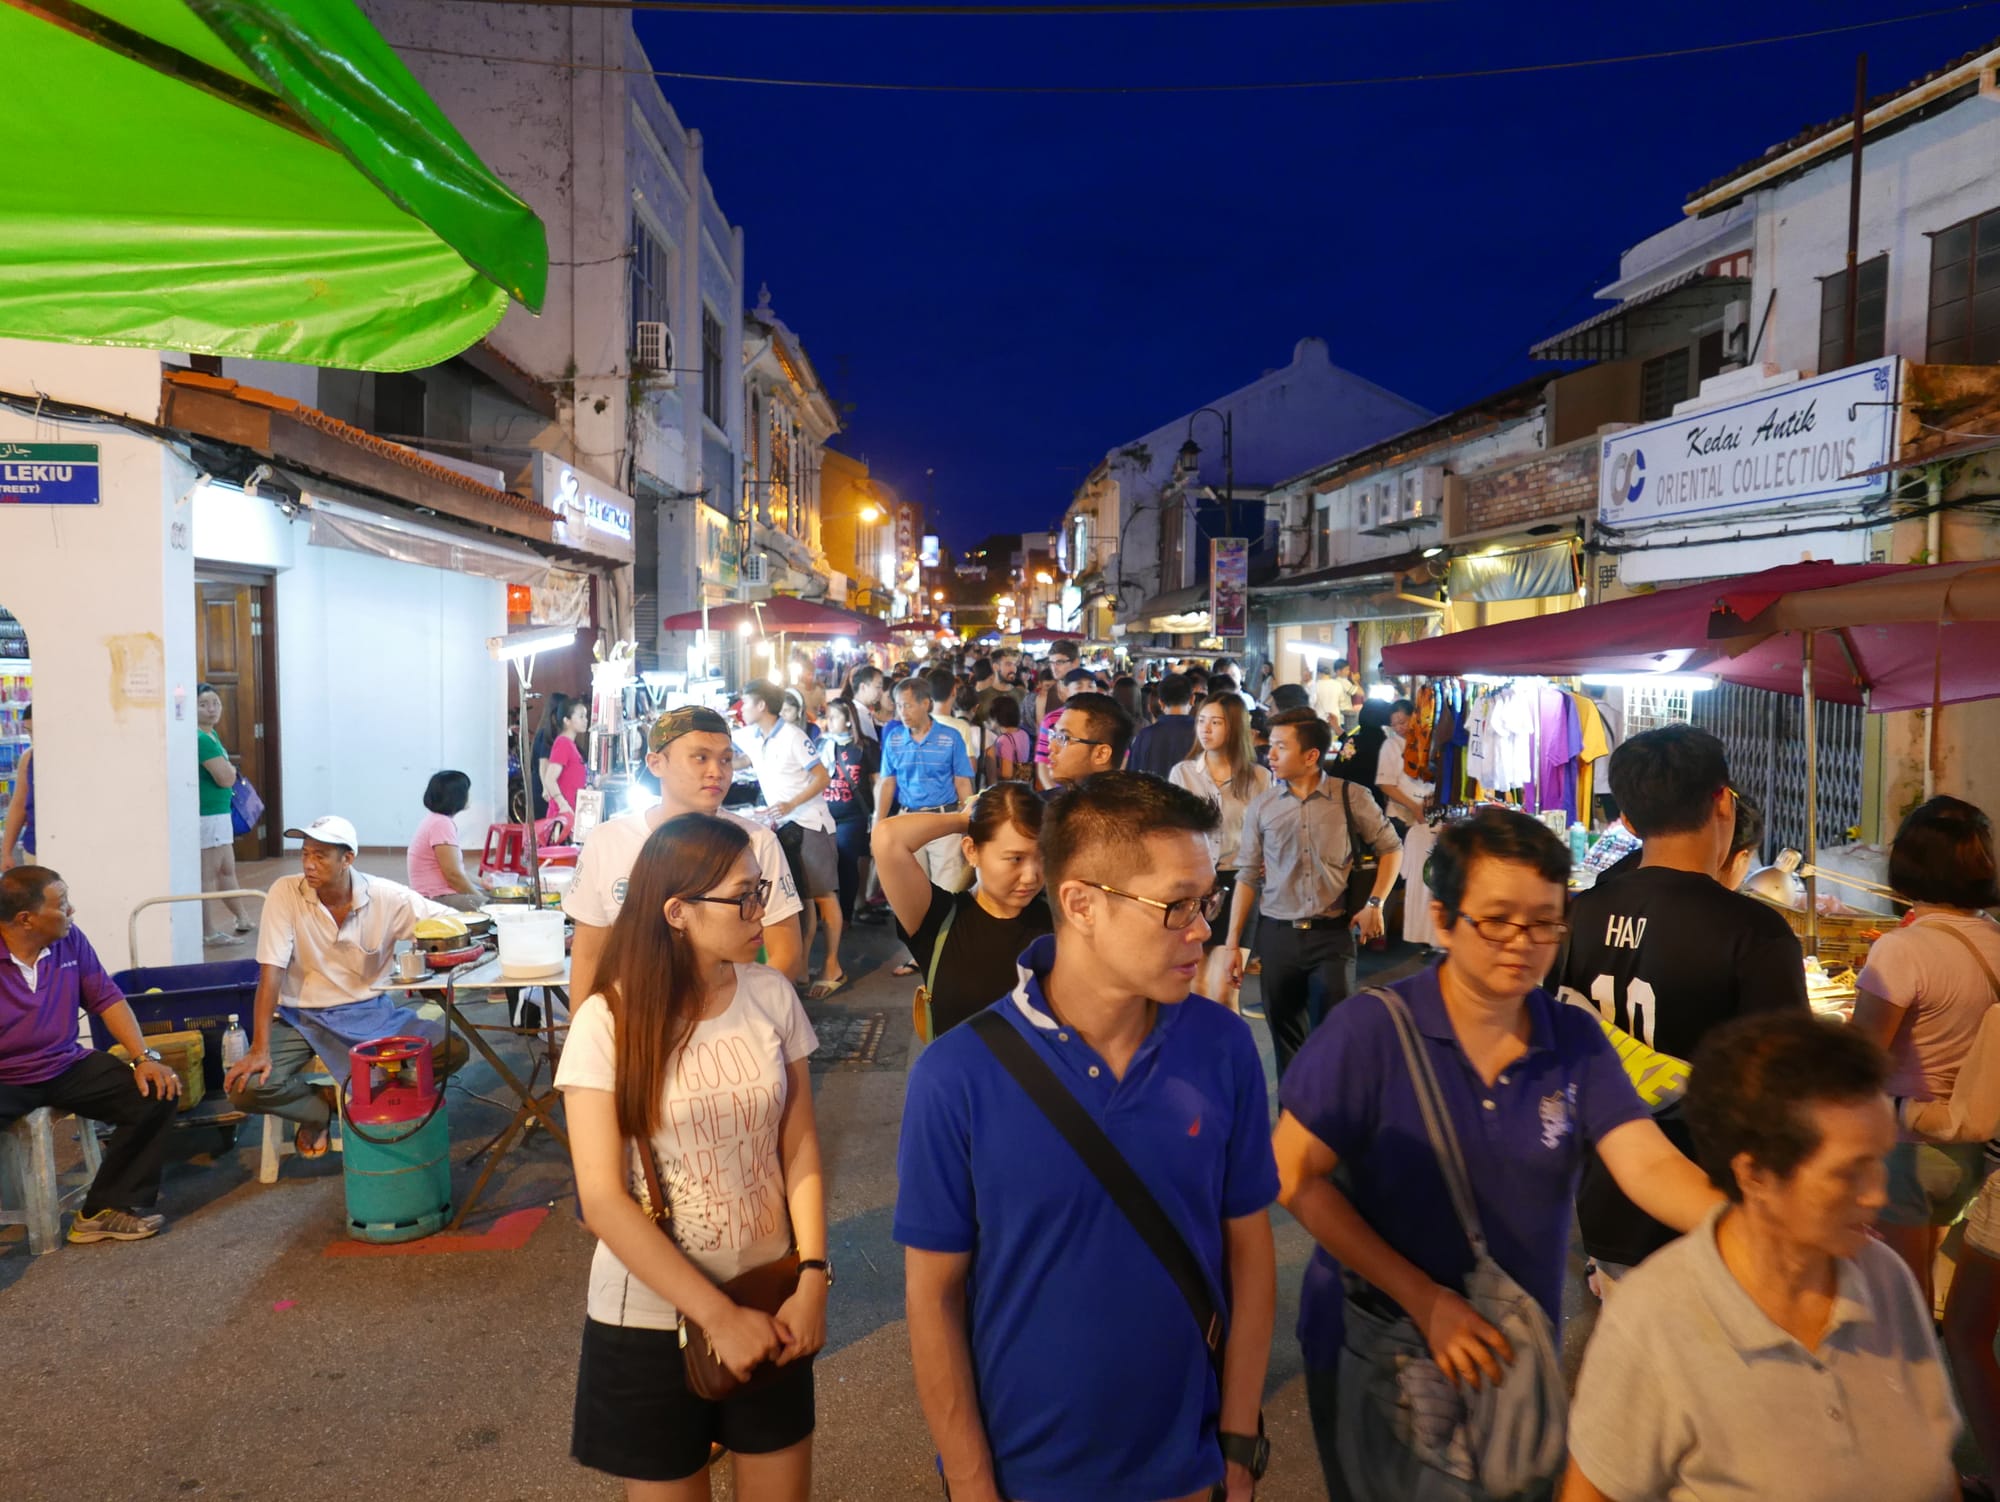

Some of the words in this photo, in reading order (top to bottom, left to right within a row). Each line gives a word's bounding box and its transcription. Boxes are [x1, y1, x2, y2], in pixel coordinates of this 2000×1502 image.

[1687, 425, 1743, 459] Kedai
[1752, 398, 1818, 446] Antik
[4, 465, 73, 482] LEKIU
[1656, 463, 1724, 507] ORIENTAL
[1732, 437, 1857, 493] COLLECTIONS
[679, 1036, 761, 1093] GOOD
[669, 1081, 785, 1148] FRIENDS
[682, 1144, 732, 1198] ARE
[737, 1128, 776, 1189] LIKE
[704, 1185, 776, 1251] STARS
